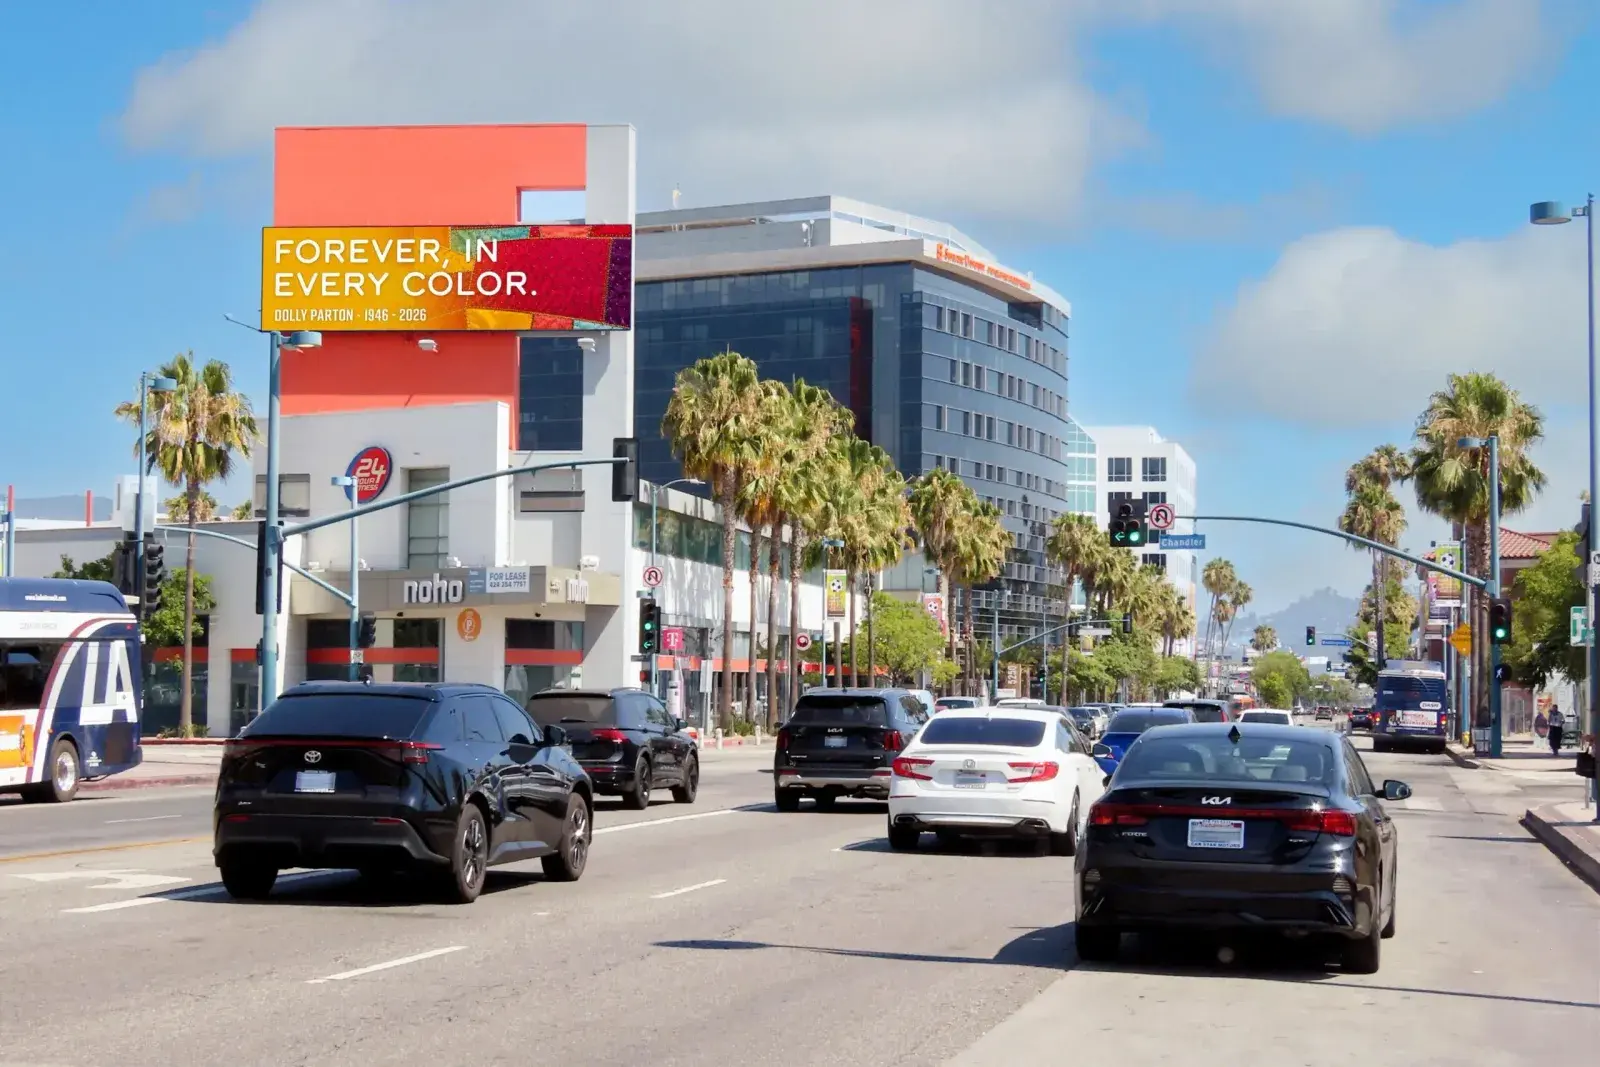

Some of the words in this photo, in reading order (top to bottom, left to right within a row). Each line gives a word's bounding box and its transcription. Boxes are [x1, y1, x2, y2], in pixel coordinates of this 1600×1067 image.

[275, 239, 449, 269] FOREVER,
[465, 238, 498, 263] IN
[275, 272, 389, 296] EVERY
[402, 271, 537, 296] COLOR.
[274, 309, 307, 322] DOLLY
[310, 309, 353, 322] PARTON
[364, 308, 389, 322] 1946
[398, 308, 428, 322] 2026
[355, 457, 387, 484] 24
[358, 477, 376, 485] OUR
[1161, 538, 1203, 547] Chandler
[403, 572, 463, 604] noho
[489, 572, 503, 581] FOR
[505, 572, 527, 581] LEASE
[79, 640, 138, 726] LA
